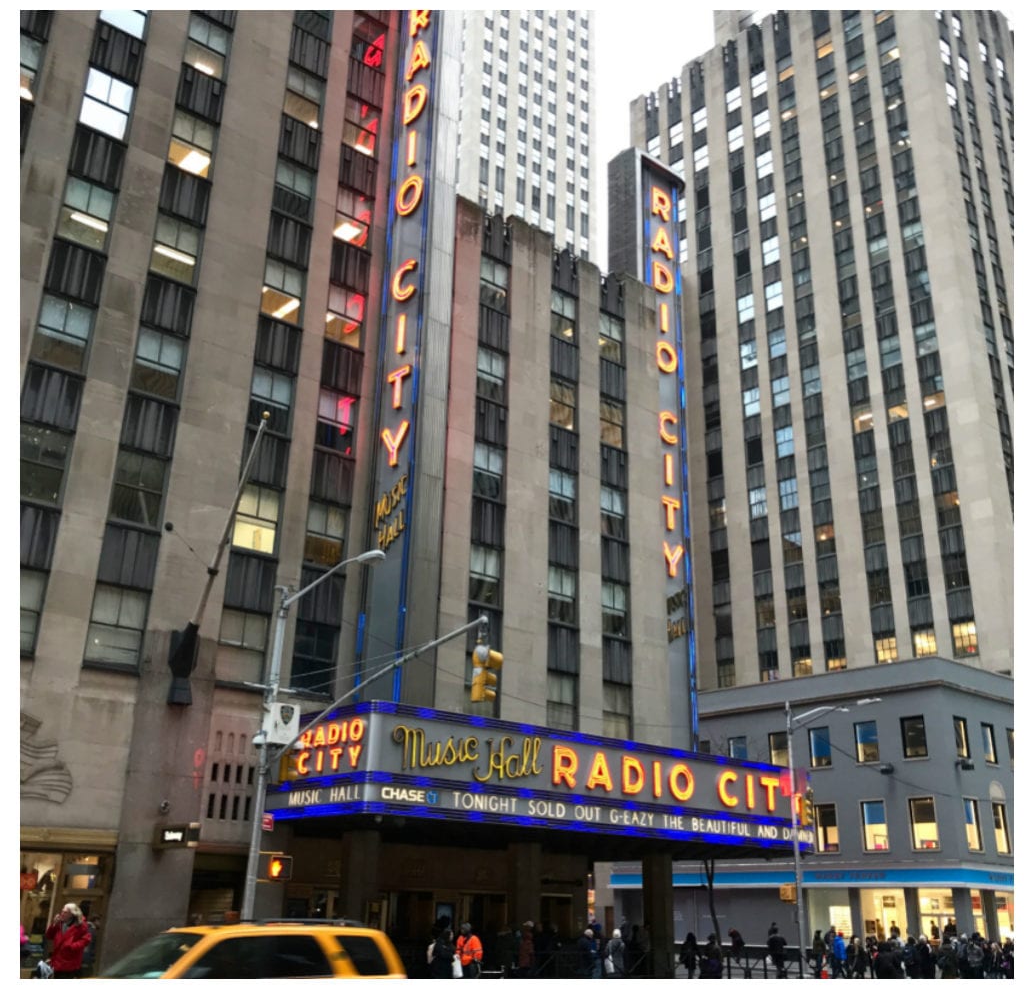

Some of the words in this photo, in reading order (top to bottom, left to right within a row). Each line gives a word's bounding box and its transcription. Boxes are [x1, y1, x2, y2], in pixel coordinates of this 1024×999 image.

[396, 10, 430, 217] RADIO
[650, 185, 678, 374] RADIO
[381, 258, 417, 467] CITY
[659, 410, 684, 578] CITY
[296, 744, 363, 775] CITY
[300, 716, 365, 749] RADIO
[393, 725, 479, 770] Music
[473, 736, 544, 782] Hall
[288, 788, 322, 807] MUSIC
[330, 785, 361, 802] HALL
[381, 786, 426, 802] CHASE
[551, 744, 695, 802] RADIO
[717, 769, 802, 814] CIT
[452, 792, 517, 813] TONIGHT
[528, 800, 566, 818] SOLD
[574, 805, 601, 822] OUT
[610, 810, 655, 827] G-EAZY
[663, 815, 684, 830] THE
[691, 818, 750, 837] BEAUTIFUL
[757, 825, 779, 840] AND
